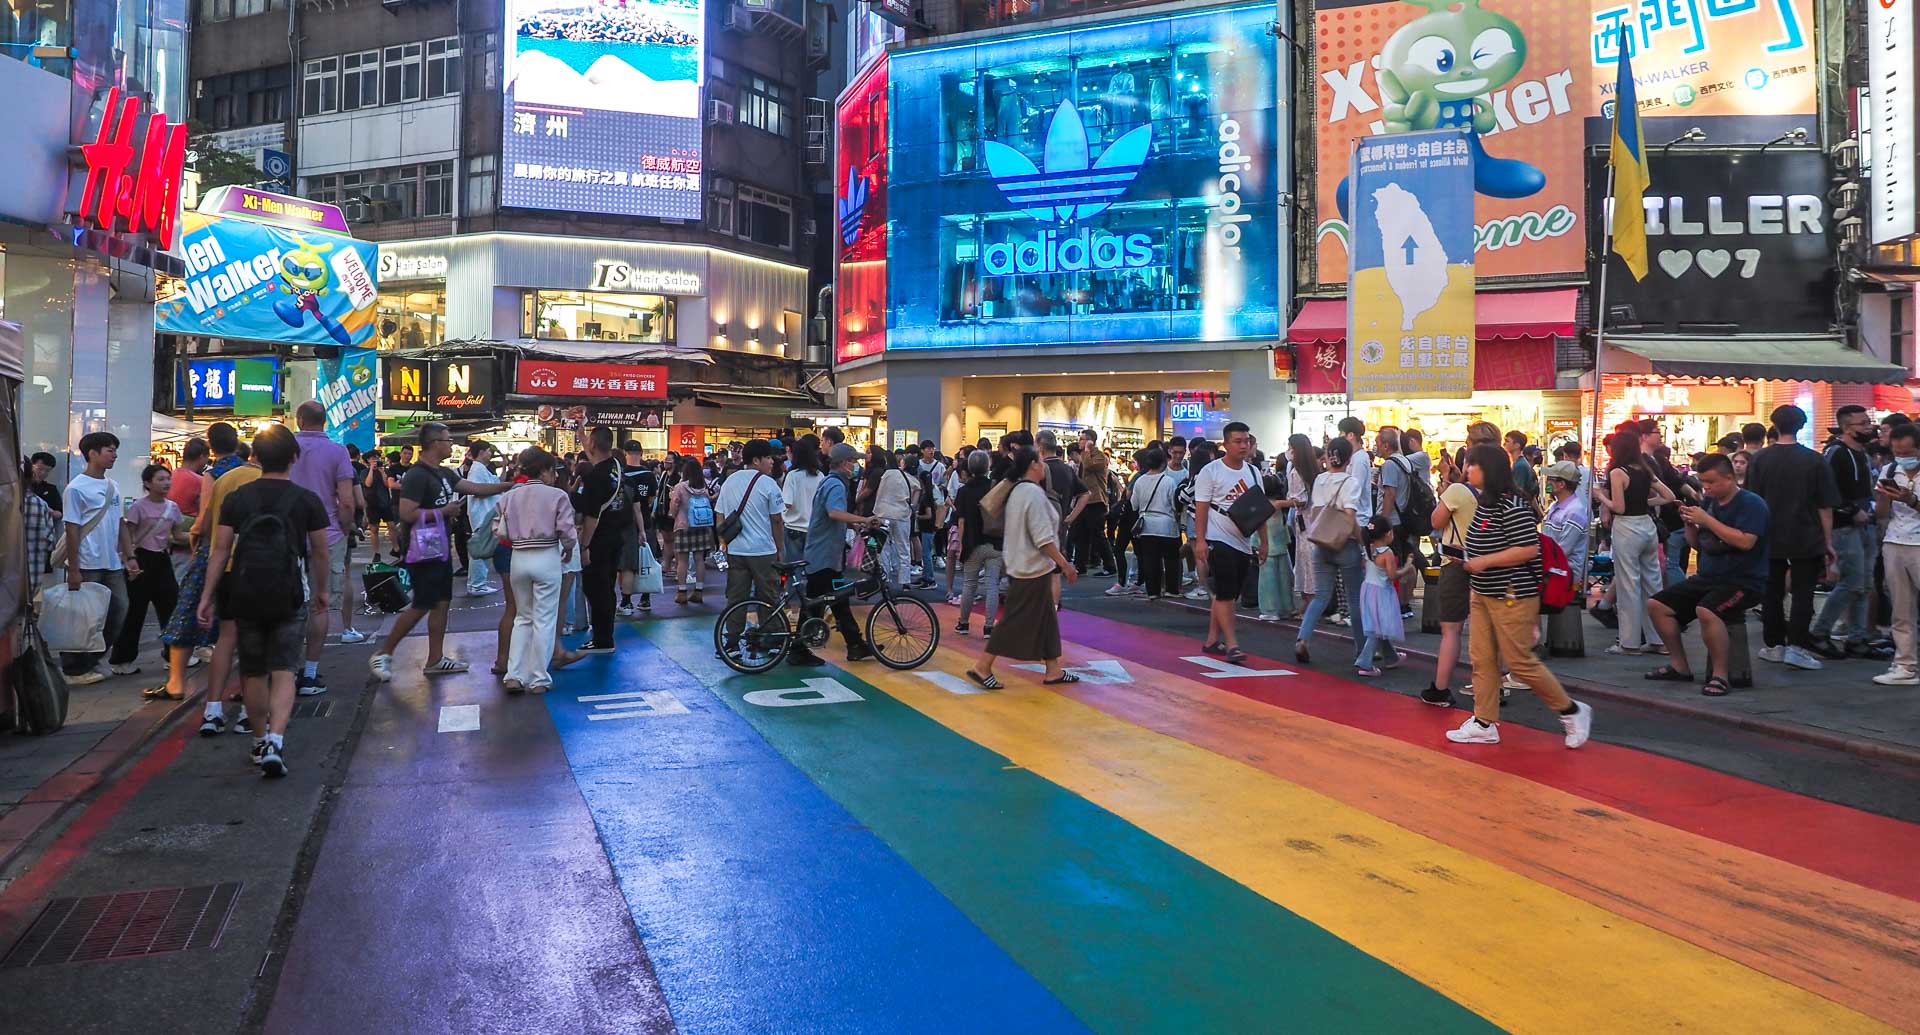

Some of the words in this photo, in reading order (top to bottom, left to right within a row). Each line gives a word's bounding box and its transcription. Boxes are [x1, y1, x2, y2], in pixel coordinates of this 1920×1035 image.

[1700, 80, 1735, 95] 西門文化
[513, 112, 568, 138] 濟州
[80, 86, 187, 250] H&M
[641, 154, 700, 174] 德威航空
[1218, 119, 1252, 262] adicolor
[242, 194, 282, 214] Xi-Men
[284, 203, 324, 222] Walker
[396, 259, 414, 270] Hair
[417, 258, 443, 271] Salon
[984, 227, 1153, 275] adidas
[1735, 249, 1760, 278] 7
[186, 247, 281, 314] Walker
[343, 252, 374, 302] WELCOME
[634, 273, 659, 285] Hair
[664, 275, 698, 288] Salon
[318, 374, 351, 409] Men
[573, 377, 656, 391] 繼光香香雞
[1172, 404, 1202, 418] OPEN
